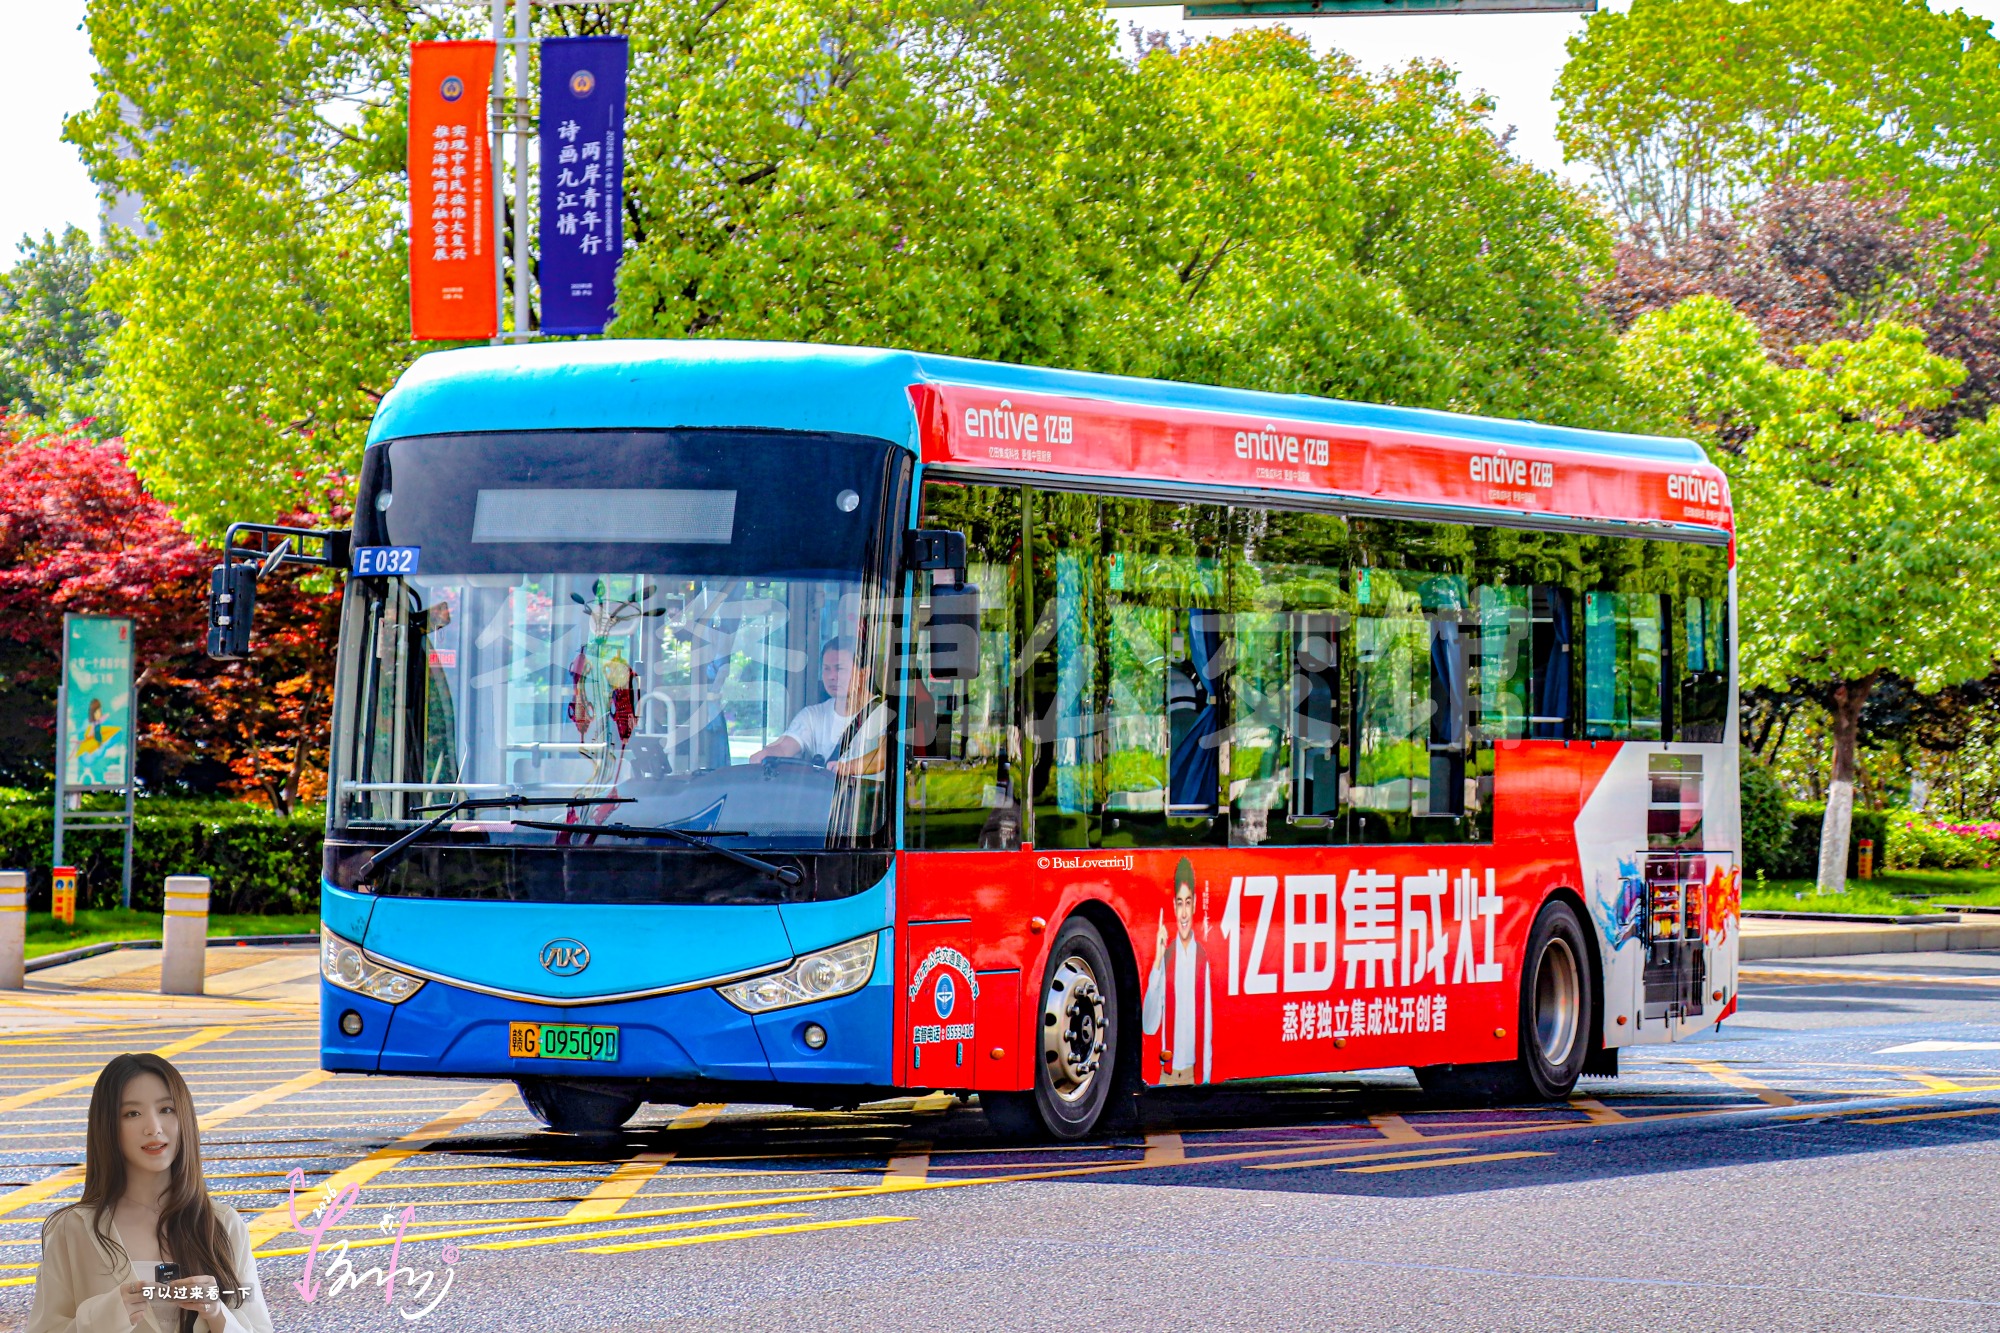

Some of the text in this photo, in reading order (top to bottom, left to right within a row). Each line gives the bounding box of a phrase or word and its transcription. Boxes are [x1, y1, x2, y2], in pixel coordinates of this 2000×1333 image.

[557, 120, 580, 235] 诗画九江情
[579, 141, 602, 255] 两岸青年行
[965, 399, 1073, 444] entive 亿田
[1235, 424, 1330, 467] entive 亿田
[1469, 448, 1553, 488] entive 亿田
[1668, 469, 1719, 506] entive
[358, 550, 413, 573] E 032
[1220, 868, 1504, 996] 亿田集成灶
[1281, 993, 1448, 1042] 蒸烤独立集成灶开创者
